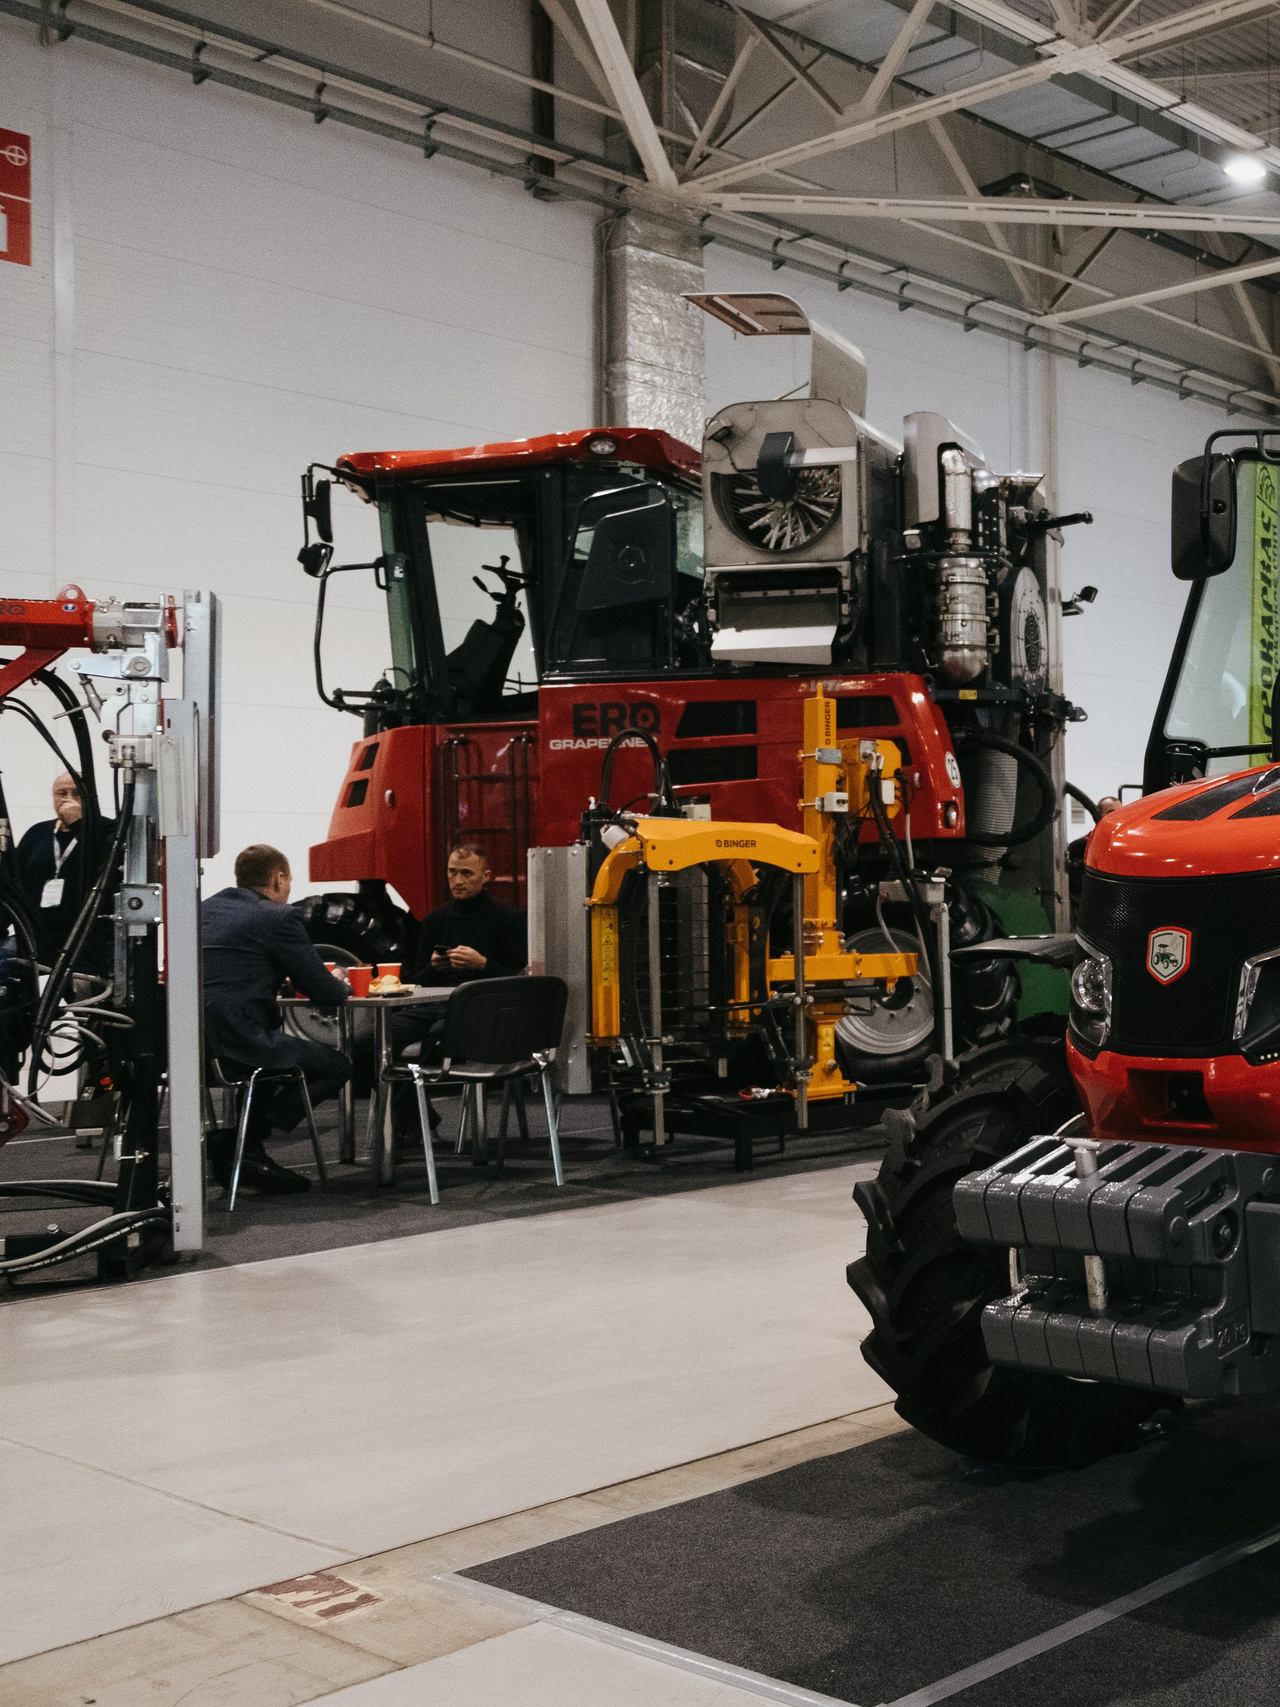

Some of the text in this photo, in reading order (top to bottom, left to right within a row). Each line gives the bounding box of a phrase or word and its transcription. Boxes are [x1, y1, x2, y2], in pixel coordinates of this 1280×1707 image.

[572, 701, 661, 737] ERO
[824, 701, 832, 736] BINGER
[723, 839, 757, 848] BINGER
